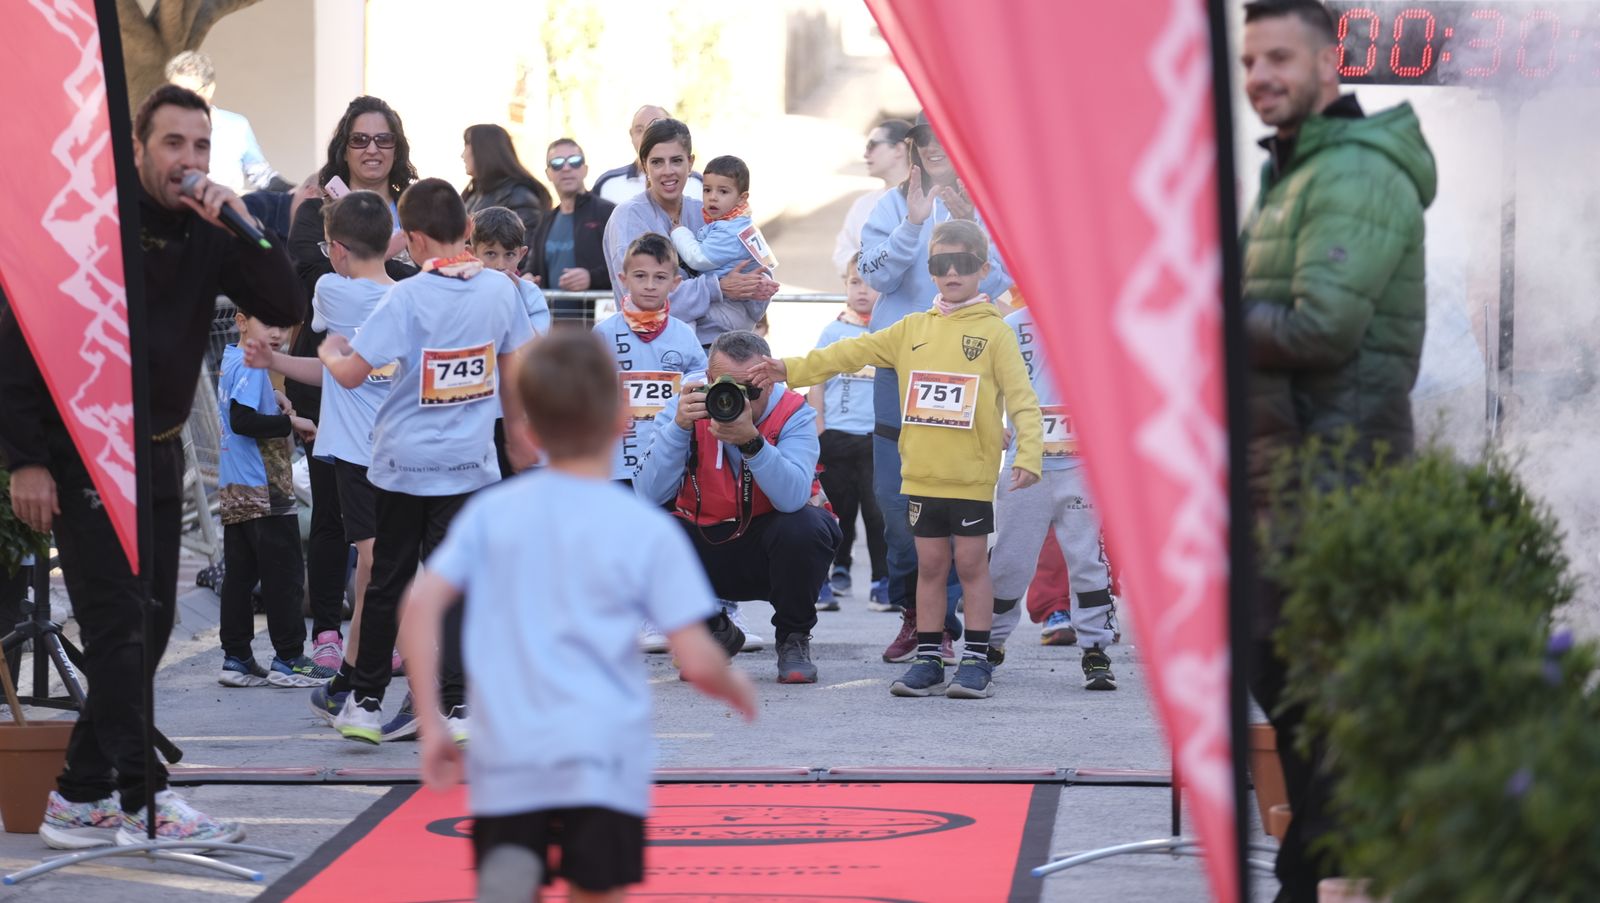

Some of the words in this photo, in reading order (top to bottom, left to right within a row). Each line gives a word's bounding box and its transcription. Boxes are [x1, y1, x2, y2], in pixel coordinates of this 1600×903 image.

[1337, 8, 1600, 77] 00:30:
[616, 333, 631, 354] LA
[1018, 322, 1033, 345] LA
[437, 358, 484, 380] 743
[630, 383, 673, 399] 728
[920, 384, 962, 403] 751
[1043, 417, 1073, 434] 71
